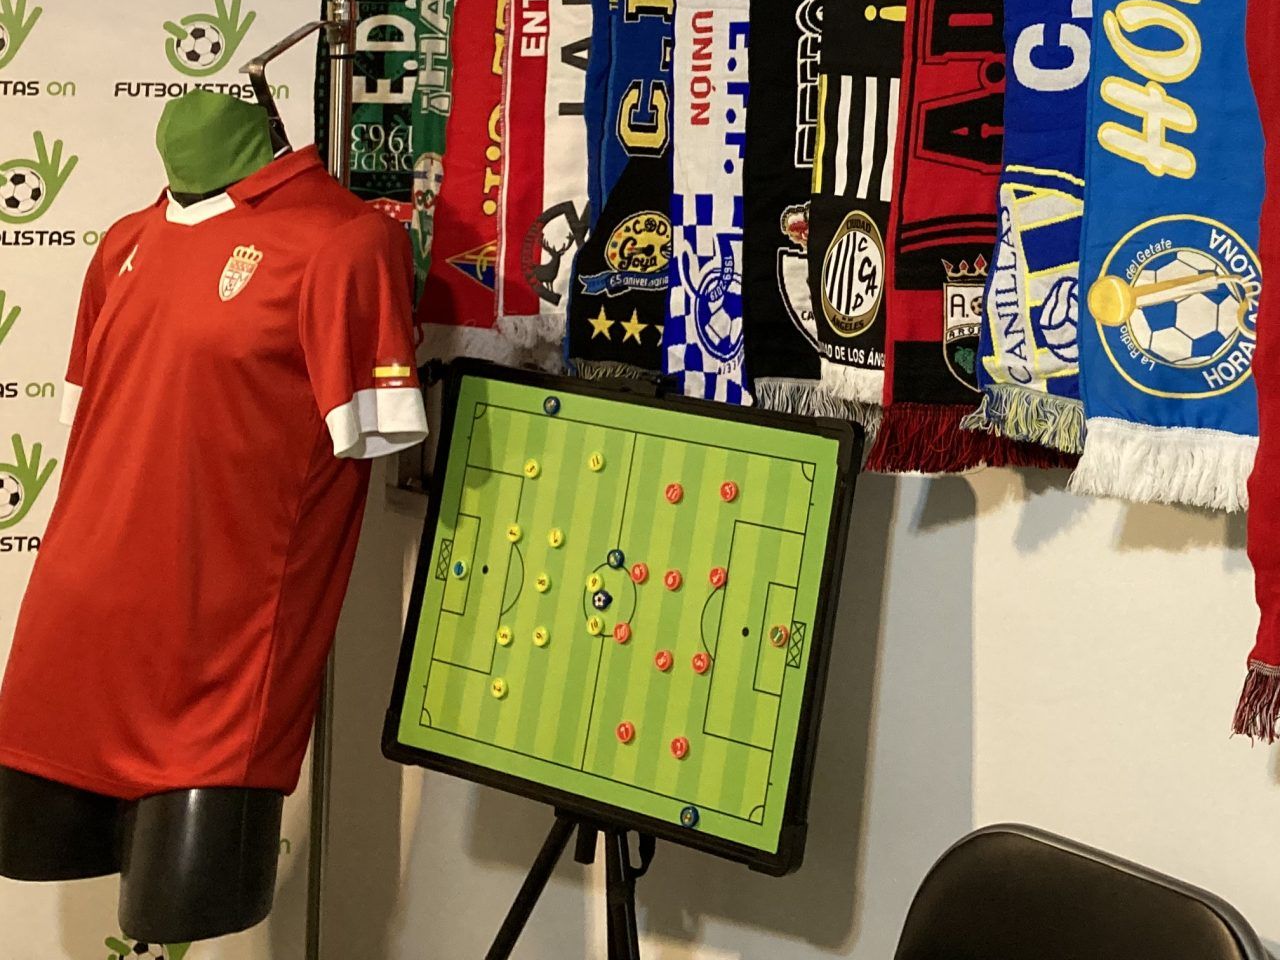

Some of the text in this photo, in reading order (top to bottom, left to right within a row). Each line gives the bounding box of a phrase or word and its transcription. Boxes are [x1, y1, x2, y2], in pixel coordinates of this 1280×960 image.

[690, 9, 718, 126] UNIÓN
[1136, 237, 1173, 262] Getafe
[995, 204, 1033, 385] CANILLAS
[834, 345, 847, 361] DE
[848, 346, 865, 365] LOS
[1201, 339, 1257, 390] HORA
